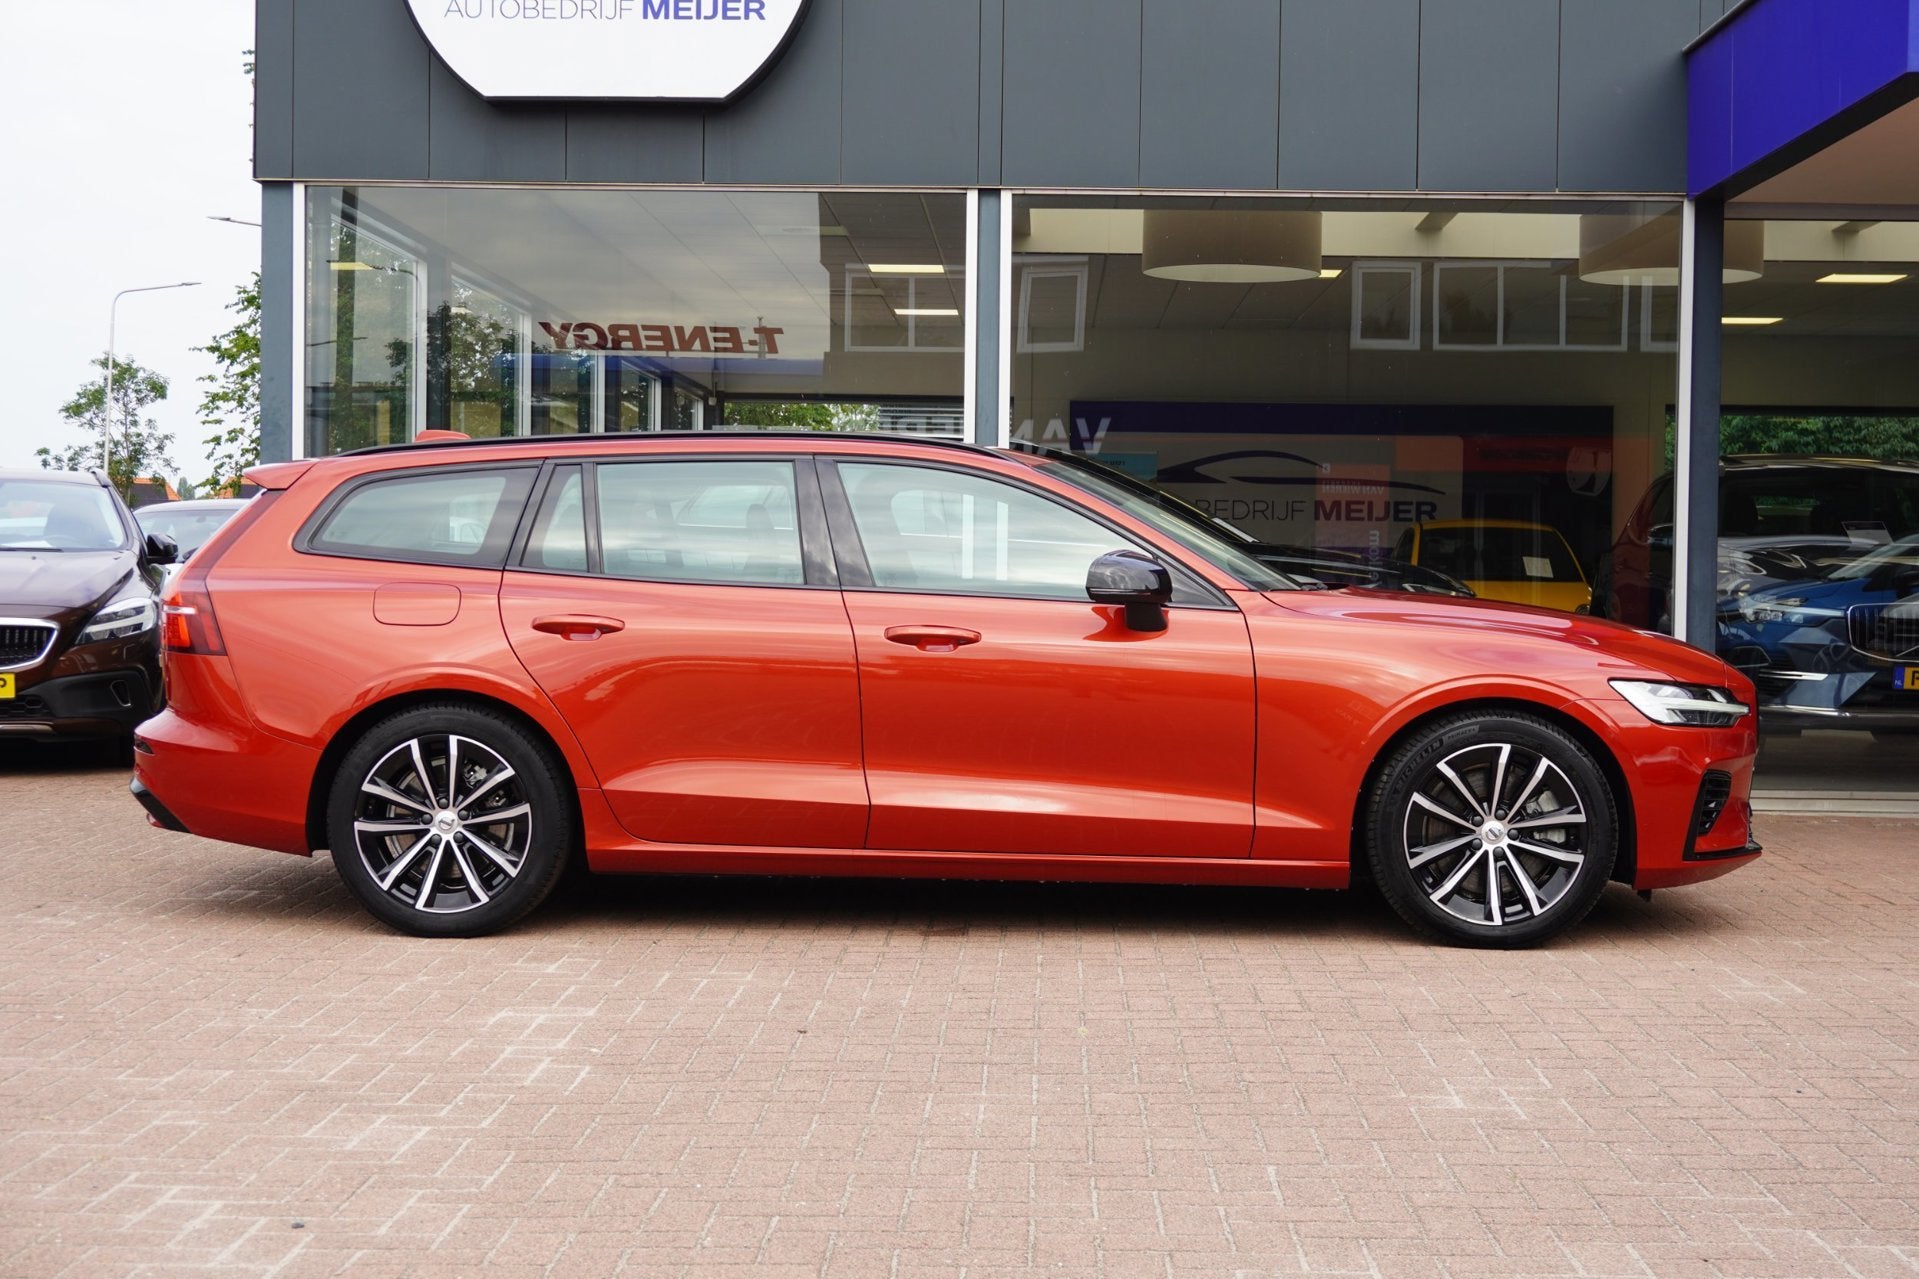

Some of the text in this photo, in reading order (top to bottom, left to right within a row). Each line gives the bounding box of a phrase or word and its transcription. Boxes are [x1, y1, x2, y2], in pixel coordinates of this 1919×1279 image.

[444, 0, 766, 20] AUTOBEDRIJF MEIJER
[1314, 500, 1438, 521] MEIJER
